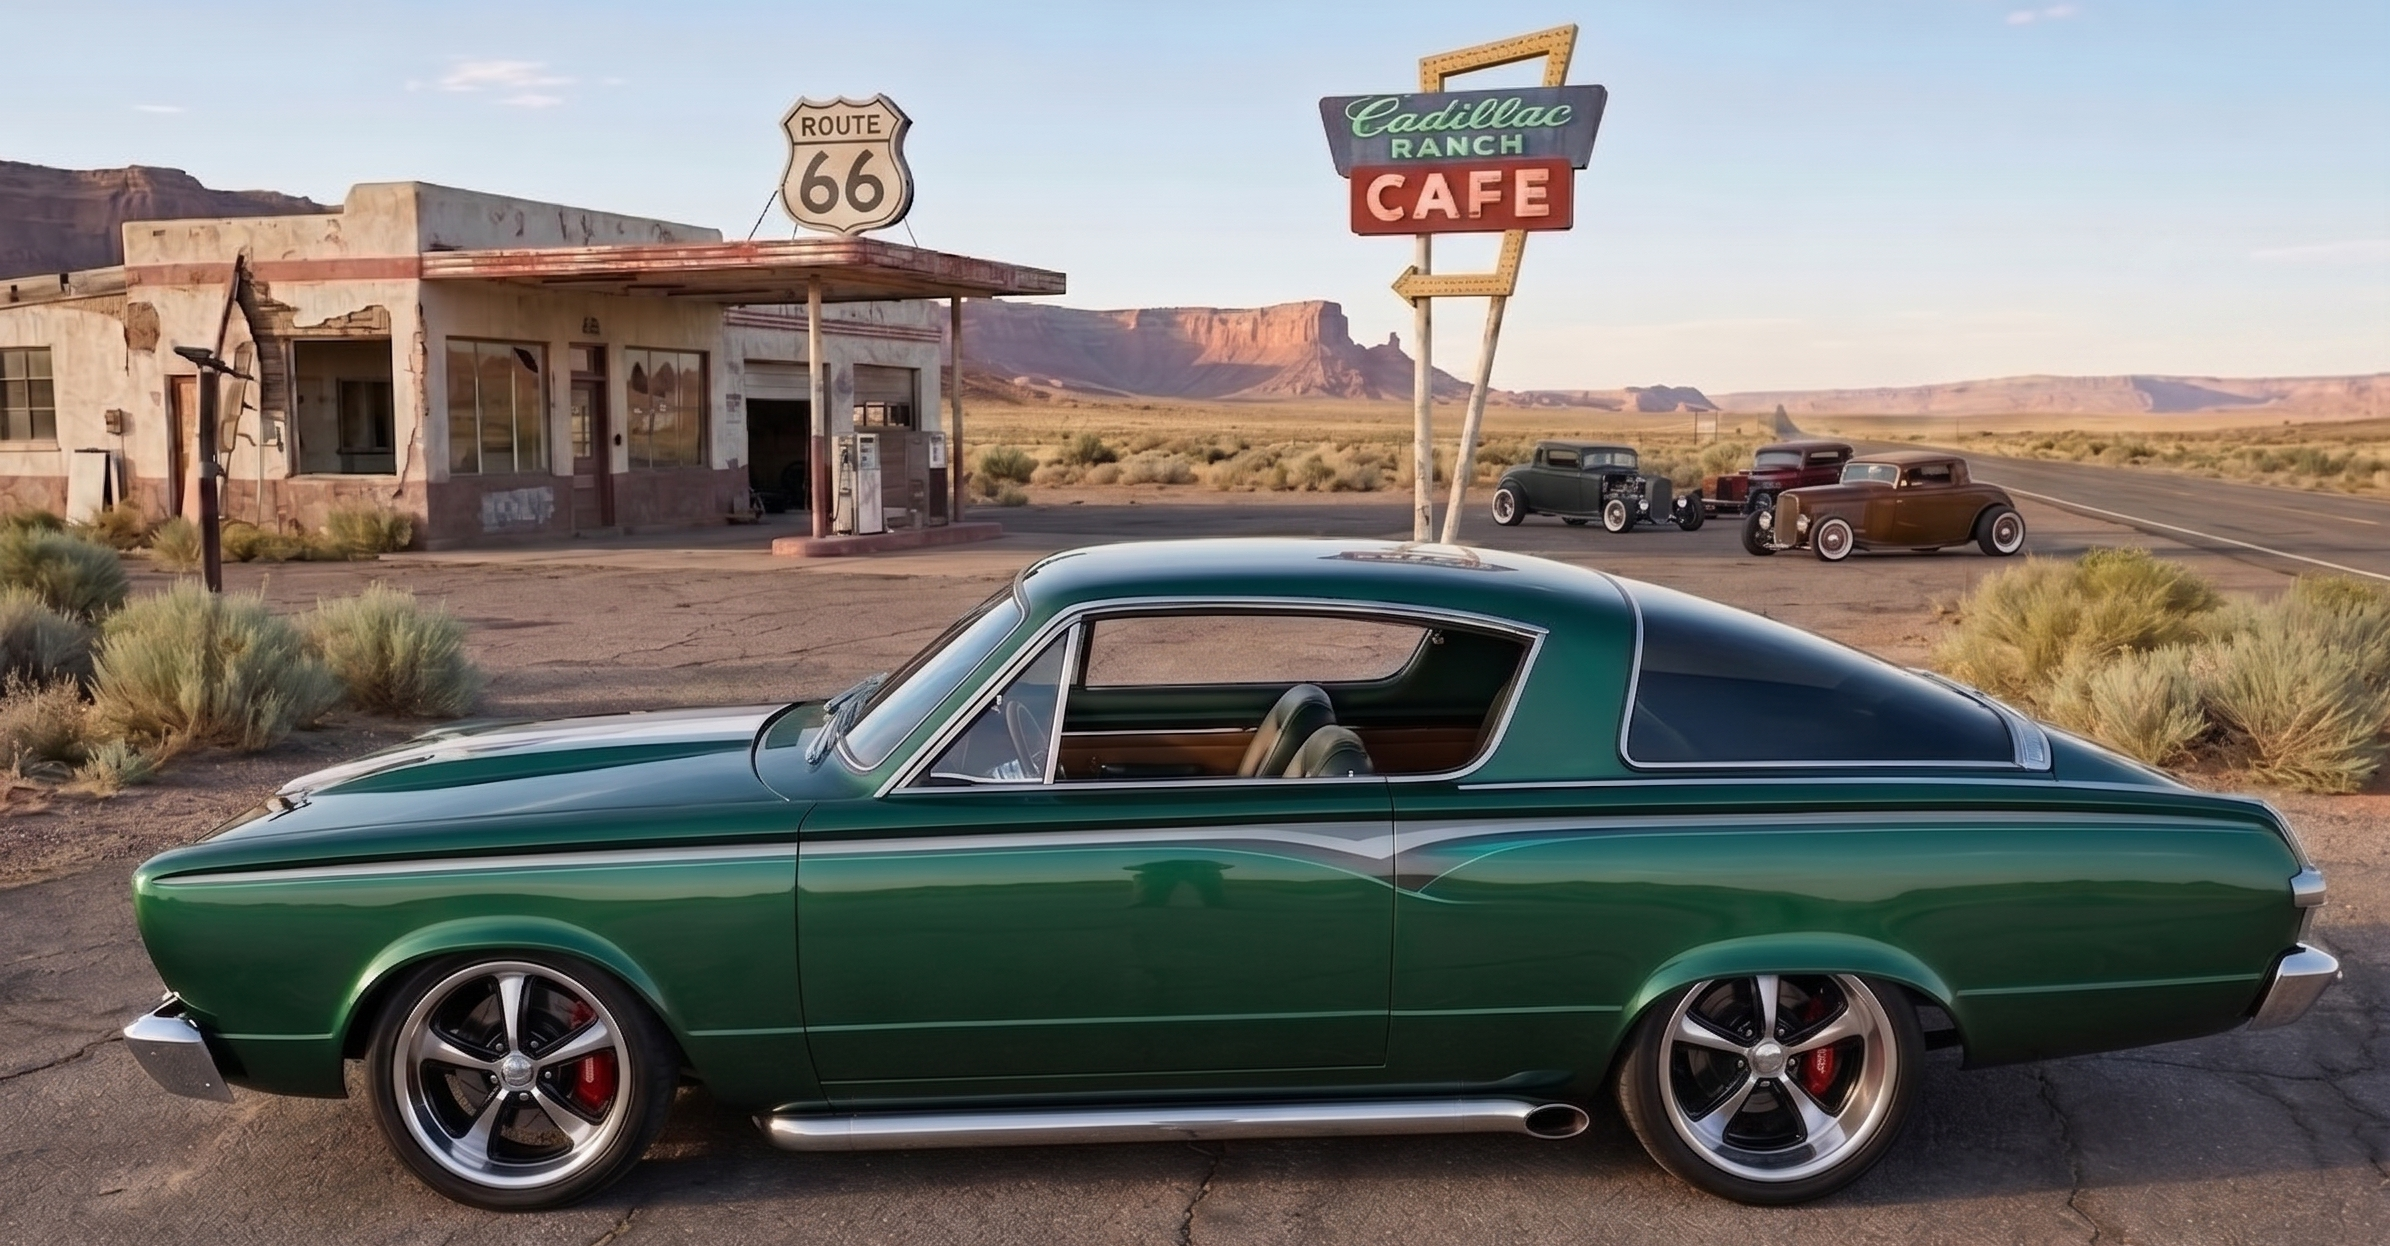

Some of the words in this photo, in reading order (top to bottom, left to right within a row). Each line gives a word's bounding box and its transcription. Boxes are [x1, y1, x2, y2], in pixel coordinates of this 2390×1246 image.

[802, 114, 881, 137] ROUTE
[1345, 95, 1573, 138] Cadillac
[1391, 133, 1523, 159] RANCH
[800, 149, 884, 214] 66
[1366, 168, 1550, 222] CAFE
